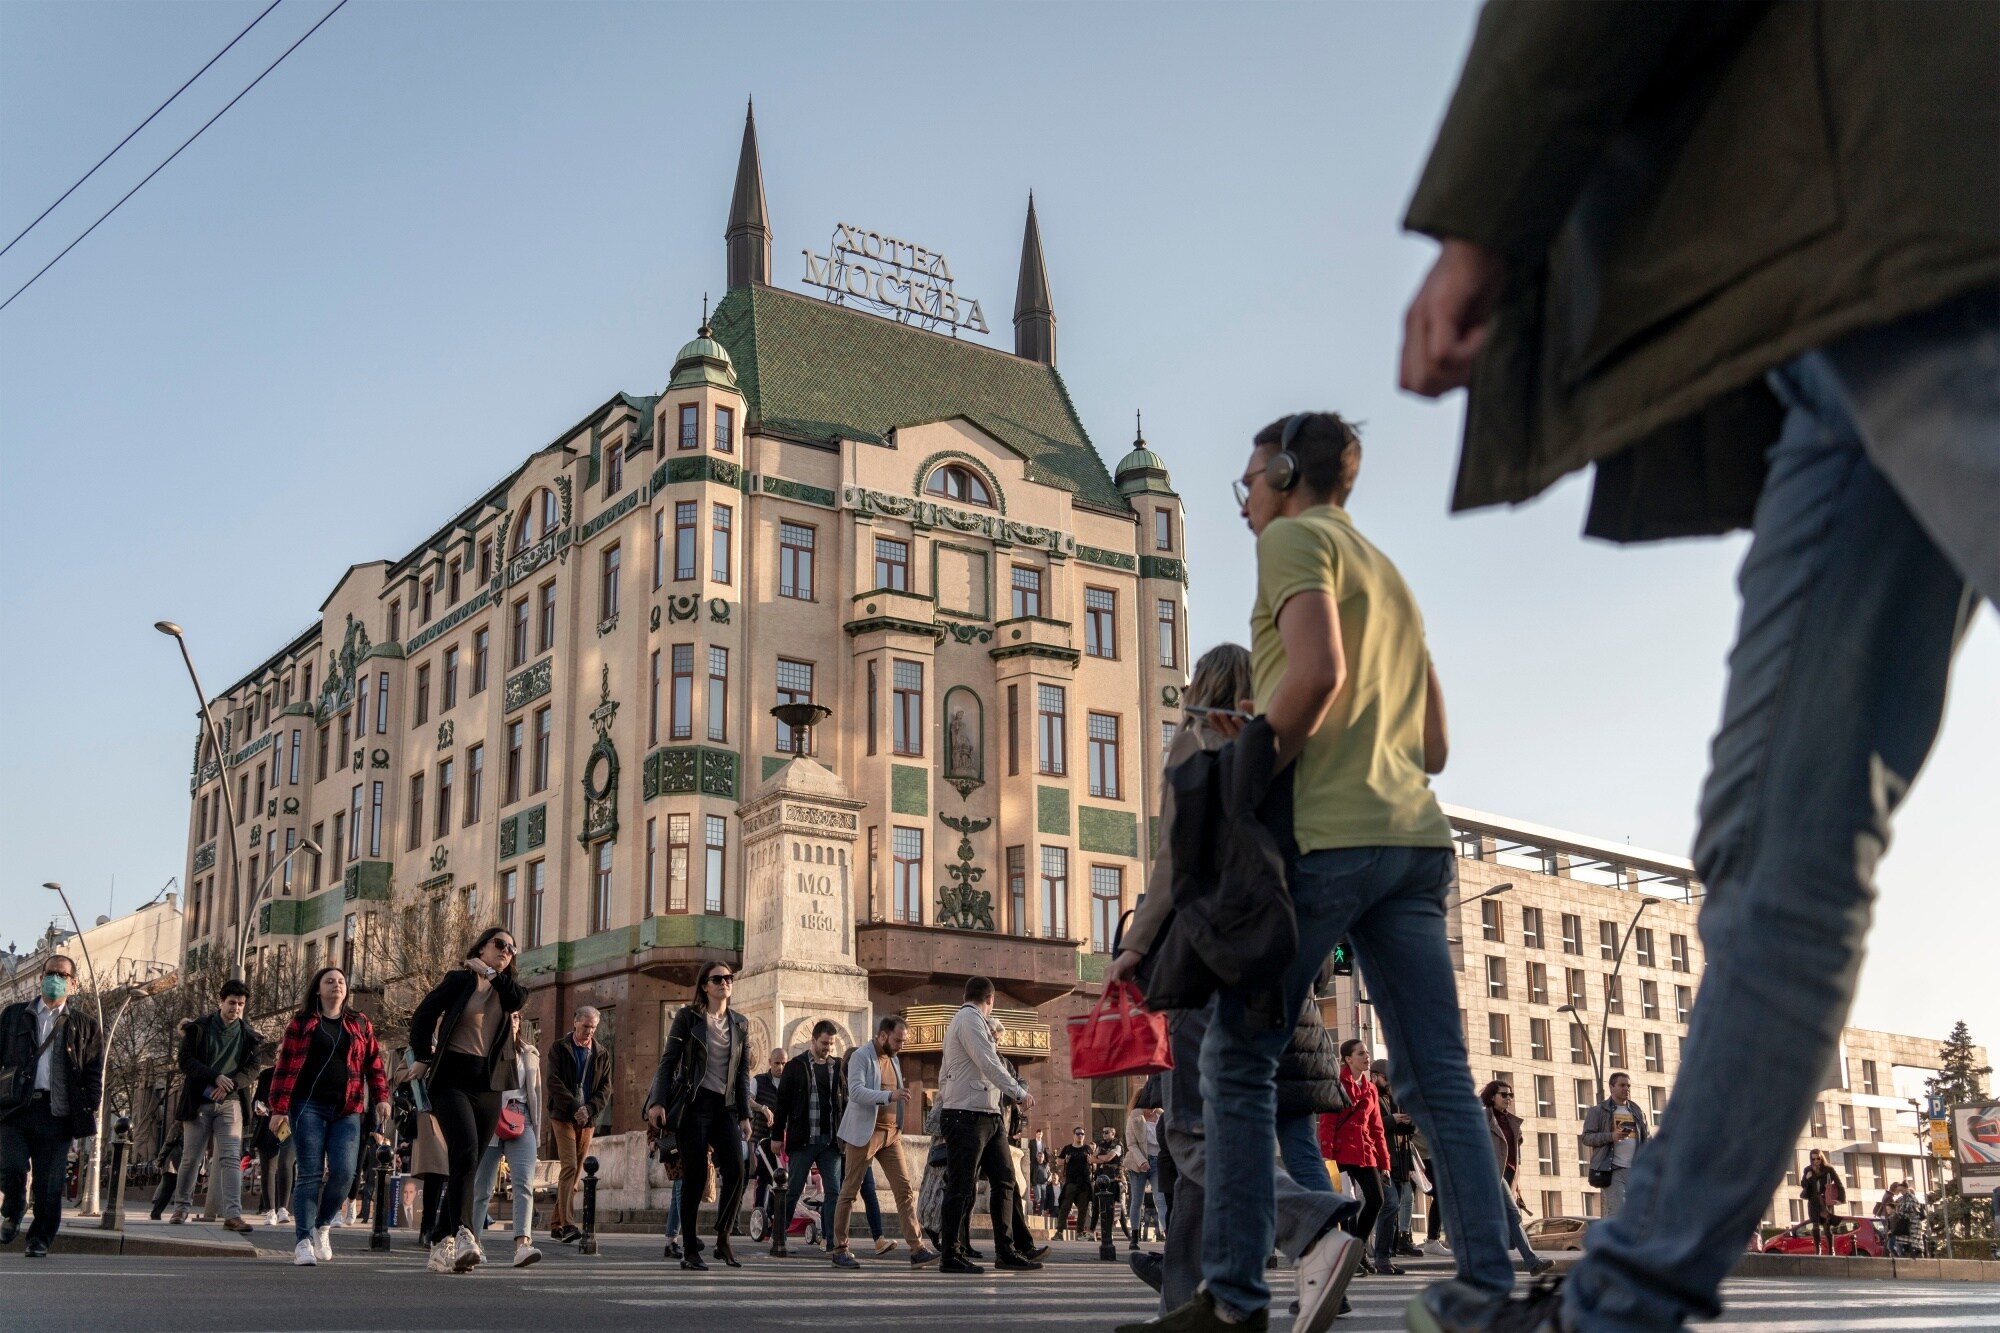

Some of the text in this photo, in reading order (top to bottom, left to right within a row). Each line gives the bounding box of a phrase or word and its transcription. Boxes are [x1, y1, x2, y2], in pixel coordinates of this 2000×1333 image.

[837, 222, 954, 282] ХОТЕЛ
[802, 249, 990, 334] МОСКВА
[1932, 1099, 1941, 1116] P
